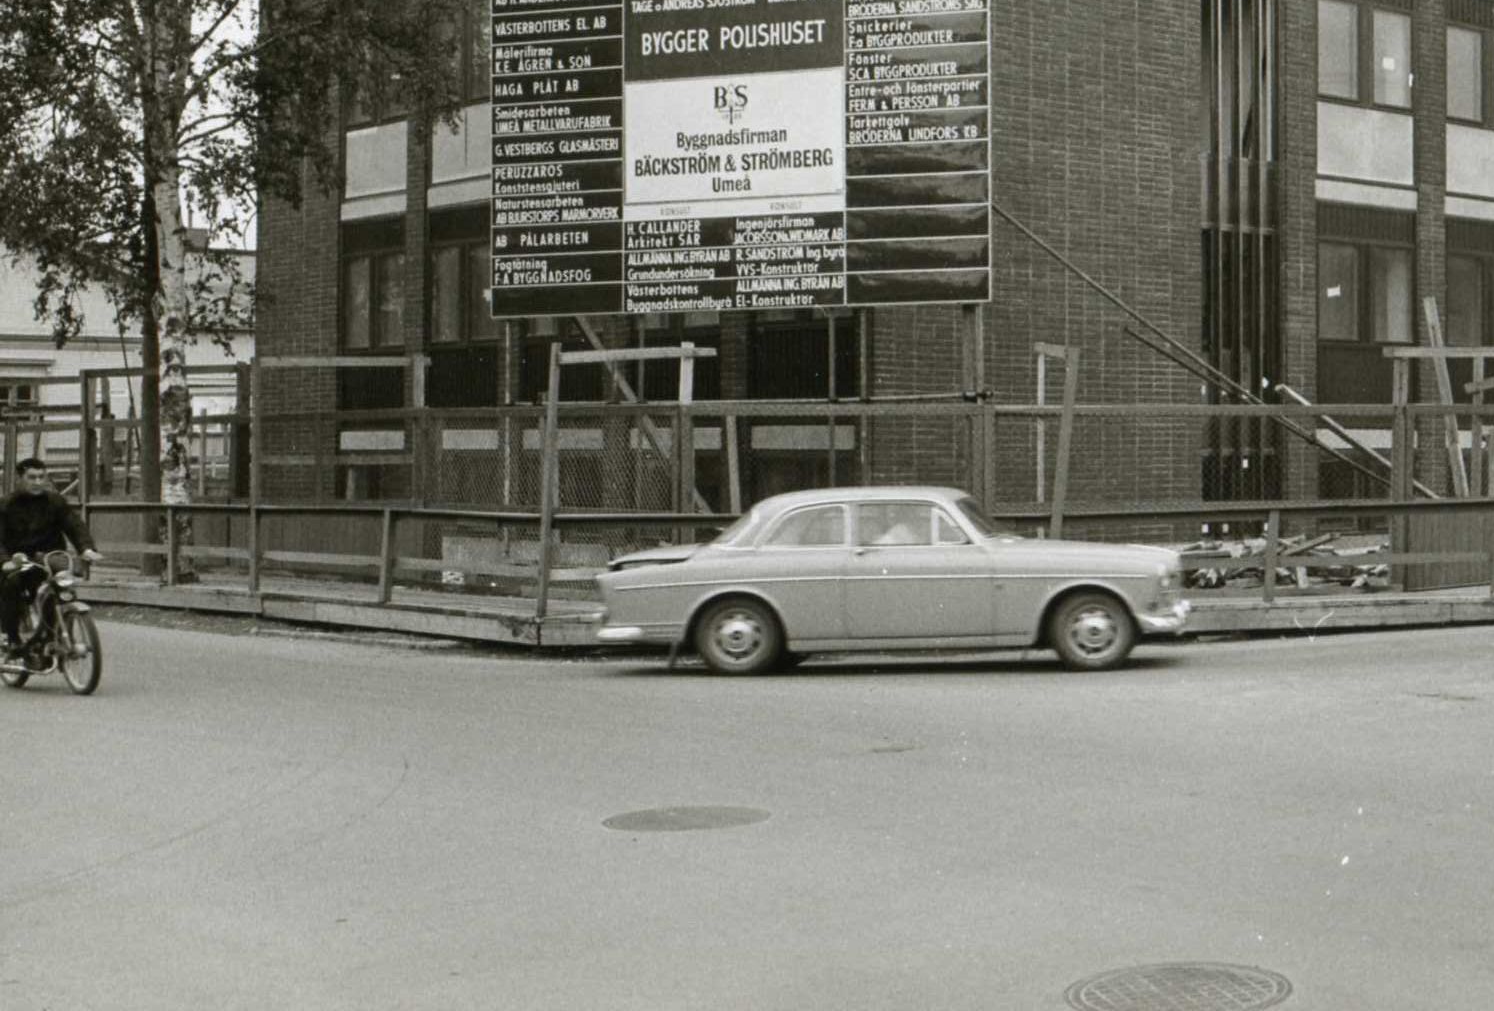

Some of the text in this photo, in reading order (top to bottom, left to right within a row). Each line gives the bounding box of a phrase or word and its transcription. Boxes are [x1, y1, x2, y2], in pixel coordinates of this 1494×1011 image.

[631, 0, 653, 14] TAGE
[593, 15, 607, 29] AB
[848, 19, 913, 34] Snickerier
[642, 20, 826, 56] BYGGER POLISHUSET
[866, 30, 953, 47] BYGGPRODUKTER
[569, 54, 591, 69] SON
[849, 53, 892, 66] Fönster
[849, 61, 958, 81] SCA BYGGPRODUKTER
[495, 78, 579, 96] HAGA PLÅT AB
[906, 79, 980, 96] fönsterpartier
[849, 98, 876, 112] FERM
[892, 94, 939, 109] PERSSON
[946, 94, 960, 107] AB
[495, 106, 570, 119] Smidesarbeten
[495, 115, 611, 134] UMEÅ METALLVARUFABRIK
[849, 113, 910, 130] Tarkettgolv
[677, 129, 787, 152] Byggnadsfirman
[908, 126, 959, 141] LINDFORS
[963, 125, 978, 138] KB
[558, 137, 619, 153] GLASMÄSTERI
[635, 148, 833, 177] BÄCKSTRÖM & STRÖMBERG
[712, 174, 751, 193] Umeå
[639, 219, 700, 234] CALLANDER
[495, 231, 589, 247] AB PÅLARBETEN
[628, 233, 700, 248] Arkitekt SAR
[718, 249, 731, 262] AB
[513, 268, 591, 285] BYGGNADSFOG
[831, 275, 845, 289] AB
[627, 283, 698, 297] Västerbottens
